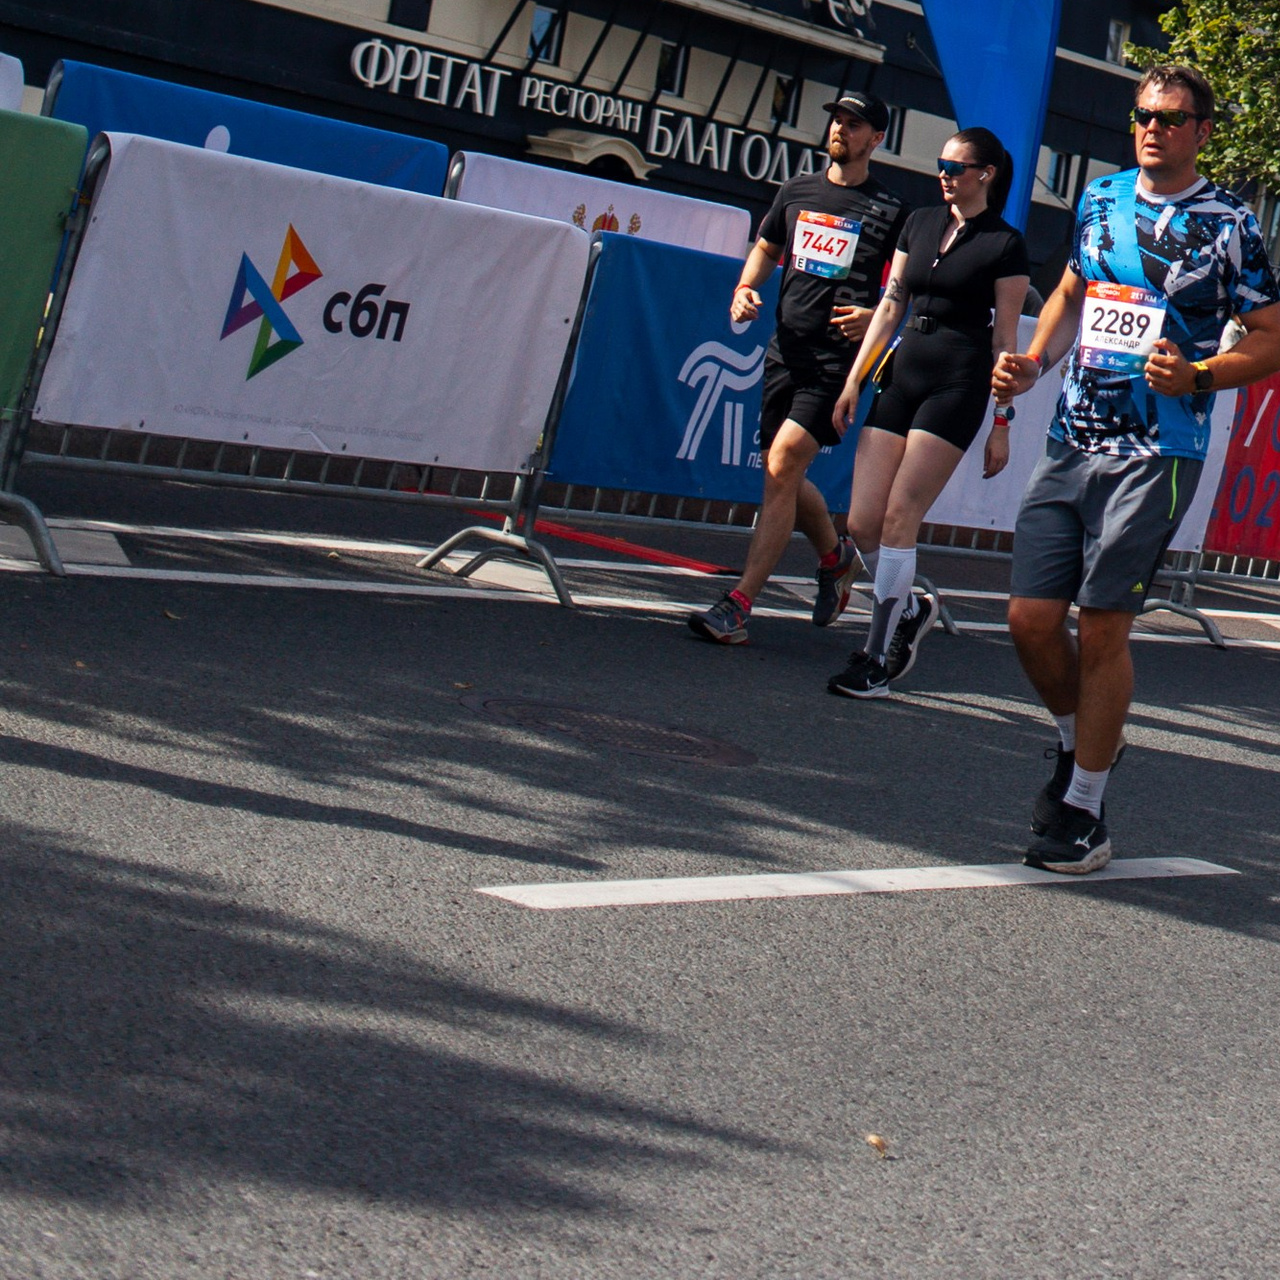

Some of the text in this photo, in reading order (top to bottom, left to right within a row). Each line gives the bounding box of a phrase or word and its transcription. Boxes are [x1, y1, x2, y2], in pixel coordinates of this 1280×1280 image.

[350, 38, 513, 117] ФРЕГАТ
[518, 76, 643, 133] РЕСТОРАН
[802, 230, 849, 258] 7447
[323, 283, 411, 343] сбп
[1090, 306, 1151, 339] 2289
